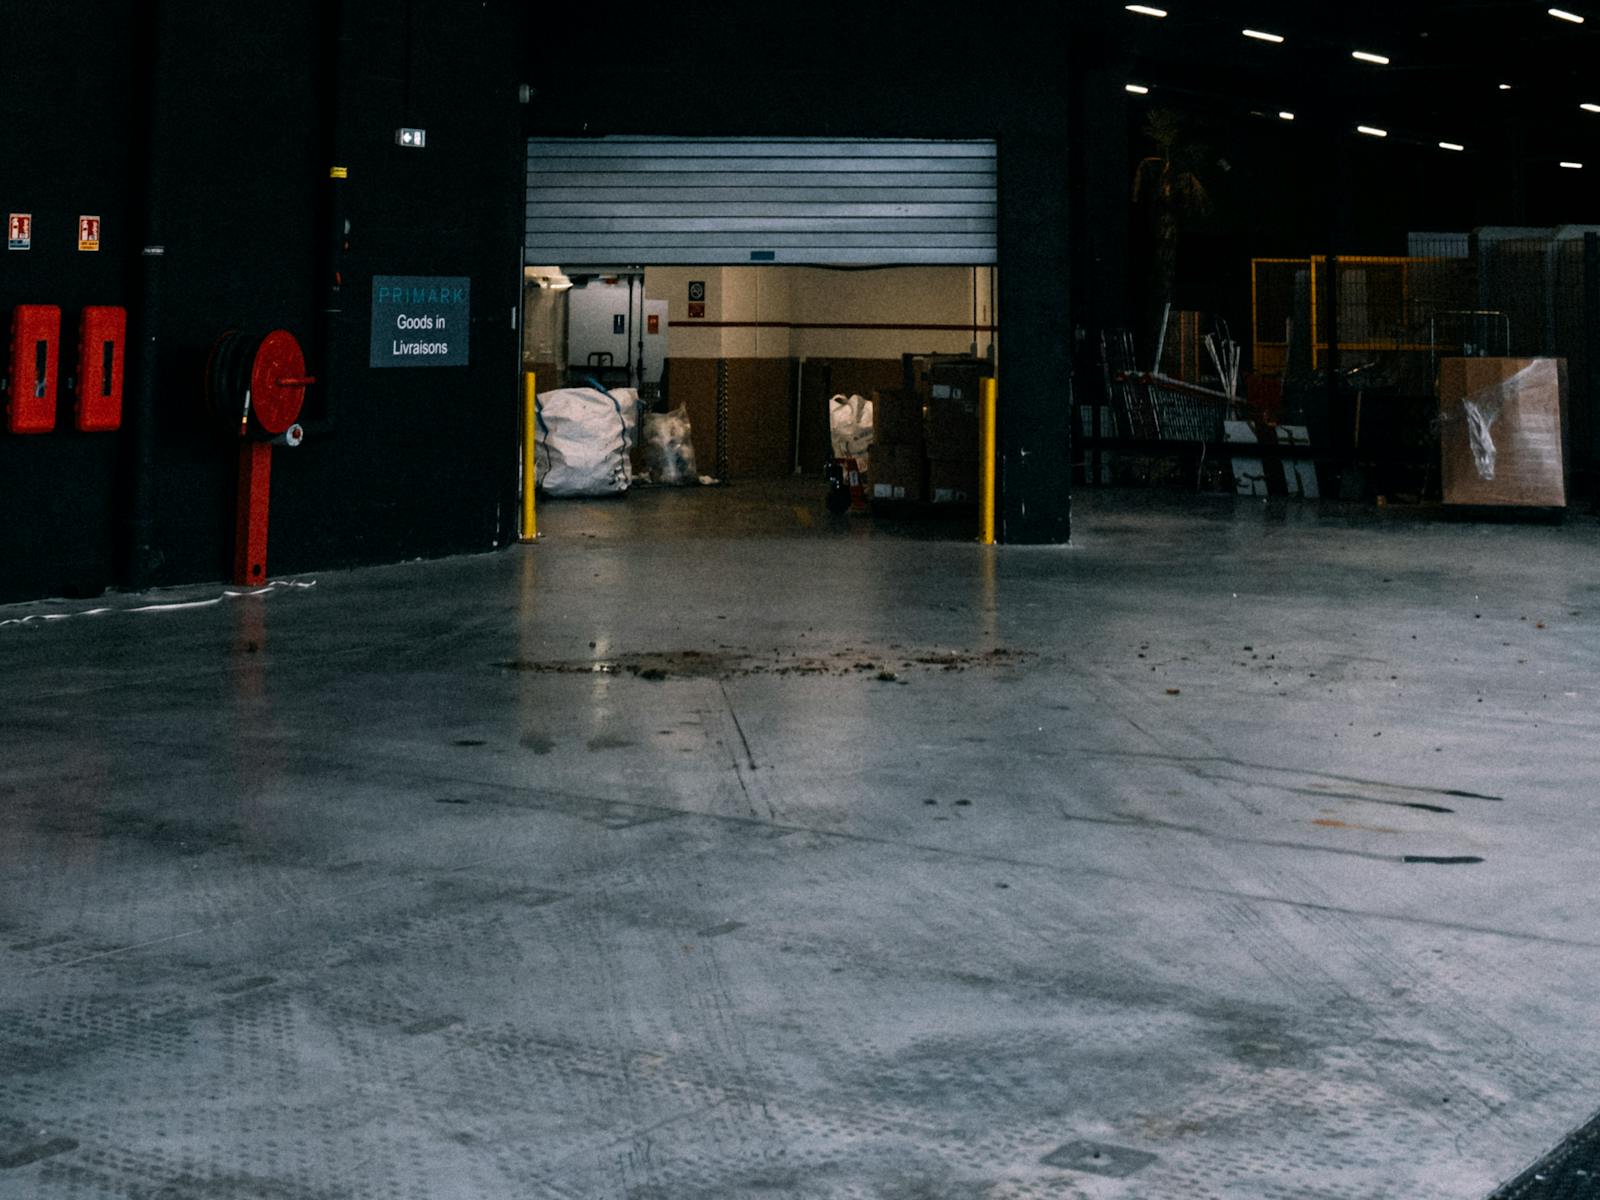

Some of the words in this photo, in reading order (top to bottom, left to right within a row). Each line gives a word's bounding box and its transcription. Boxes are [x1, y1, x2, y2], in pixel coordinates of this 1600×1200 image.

[379, 287, 463, 304] PRIMARK
[397, 314, 433, 329] Goods
[435, 314, 446, 329] in
[392, 340, 448, 355] Livraisons
